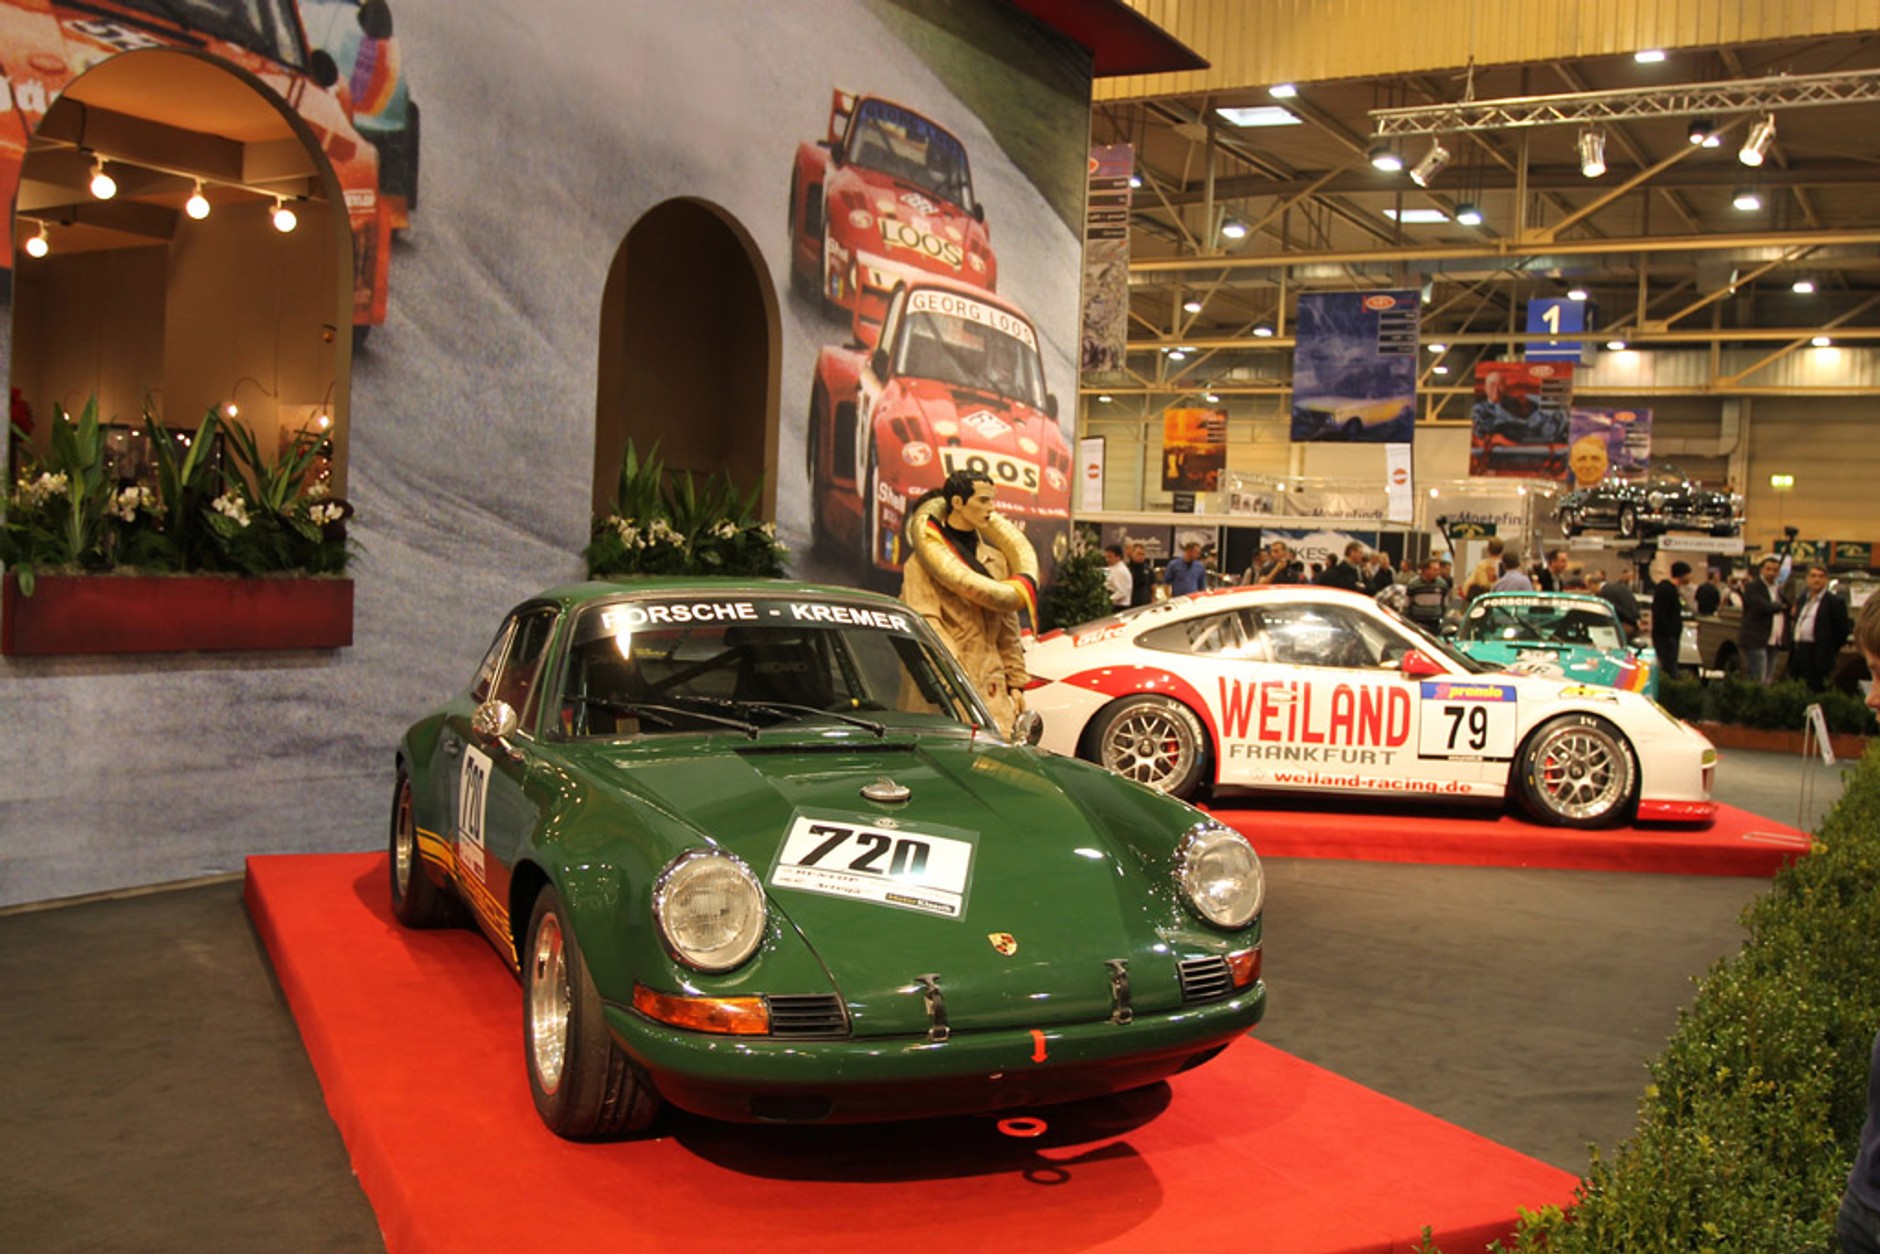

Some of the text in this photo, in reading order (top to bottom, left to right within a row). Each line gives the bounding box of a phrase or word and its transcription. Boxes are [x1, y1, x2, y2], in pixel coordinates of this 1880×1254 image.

[881, 220, 963, 267] LOOS
[912, 294, 1032, 345] GEORG LOOS
[1542, 304, 1560, 346] 1
[944, 453, 1038, 489] LOOS
[601, 602, 758, 630] PORSCHE
[790, 603, 911, 633] KREMER
[1444, 705, 1488, 751] 79
[1229, 743, 1397, 766] FRANKFURT
[1274, 771, 1473, 794] weiland-racing.de
[798, 824, 931, 875] 720
